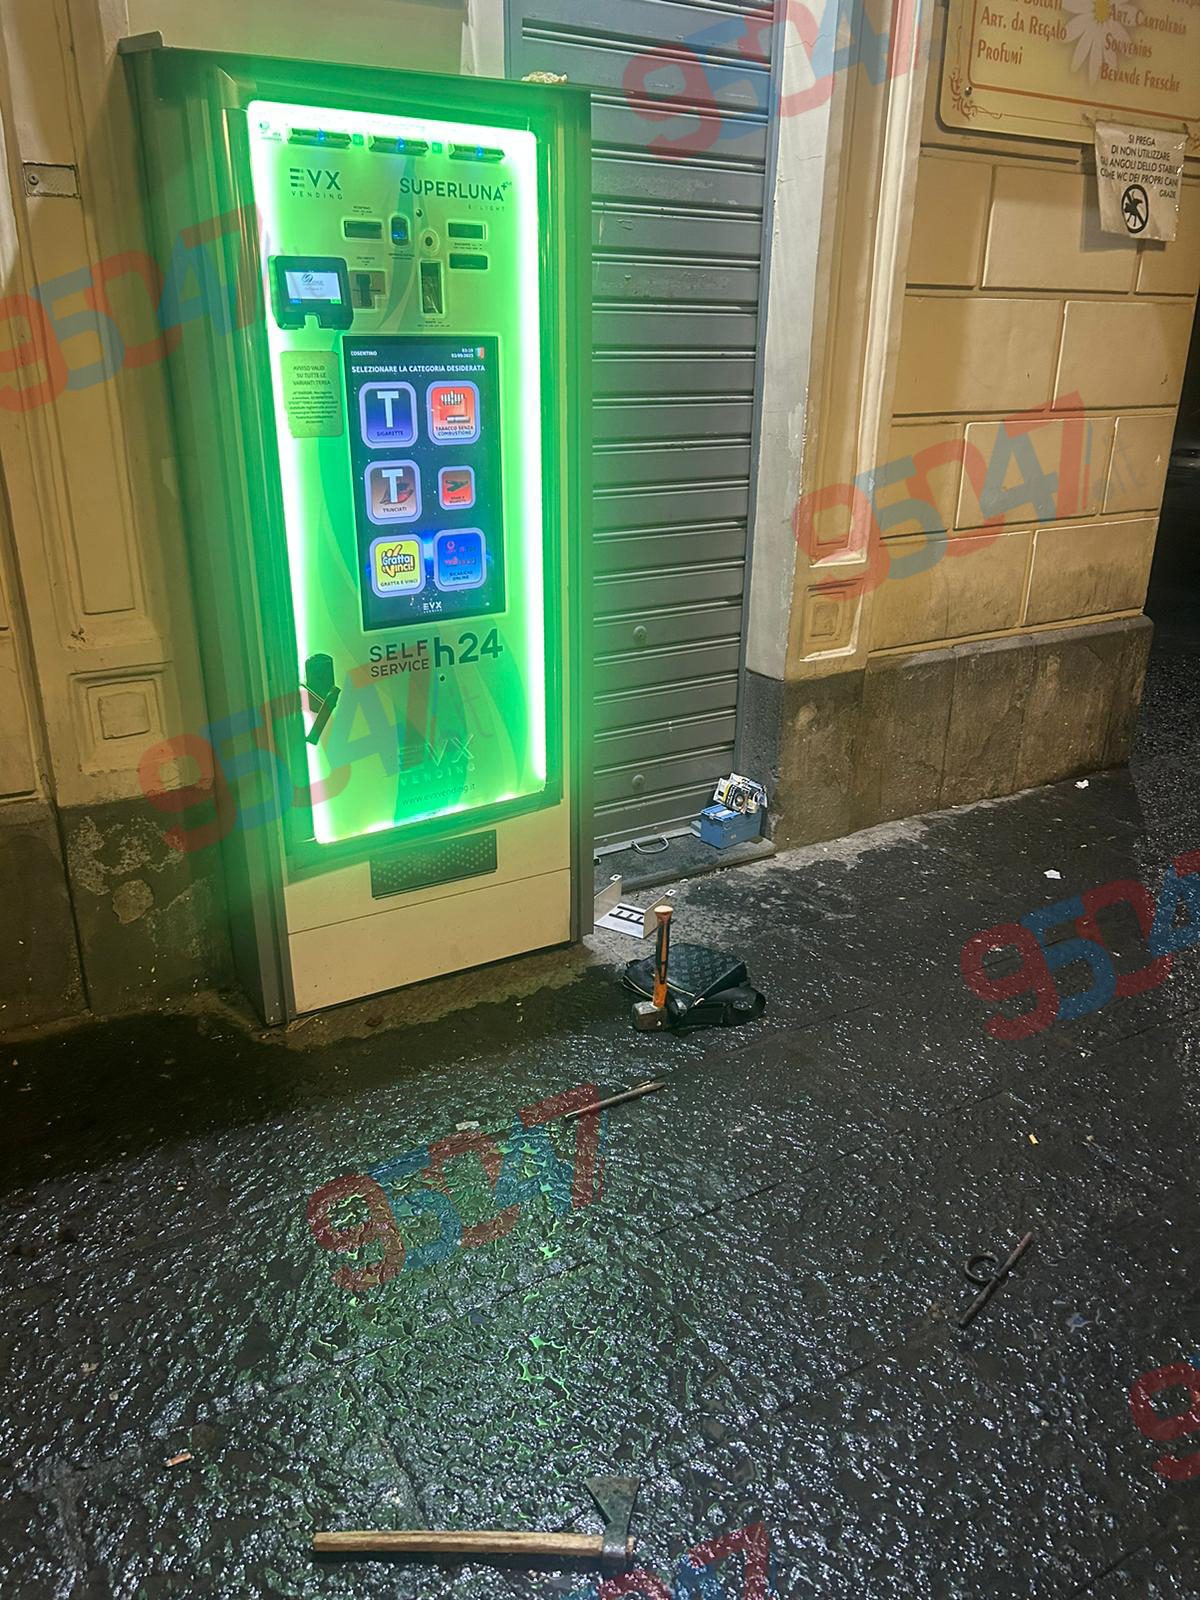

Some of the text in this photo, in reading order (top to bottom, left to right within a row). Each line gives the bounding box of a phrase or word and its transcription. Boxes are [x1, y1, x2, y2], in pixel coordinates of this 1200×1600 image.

[1128, 134, 1156, 147] SI PREGA
[1111, 145, 1171, 161] DI NON UTILIZZARE
[1137, 161, 1157, 172] DELLO
[1117, 171, 1127, 182] WC
[291, 191, 343, 201] VENDING
[351, 365, 398, 373] SELEZIONARE
[376, 391, 399, 428] T
[382, 469, 403, 503] T
[383, 554, 410, 566] Gratta
[423, 601, 442, 610] EVX
[369, 628, 504, 668] SELF h24
[370, 658, 430, 678] SERVICE
